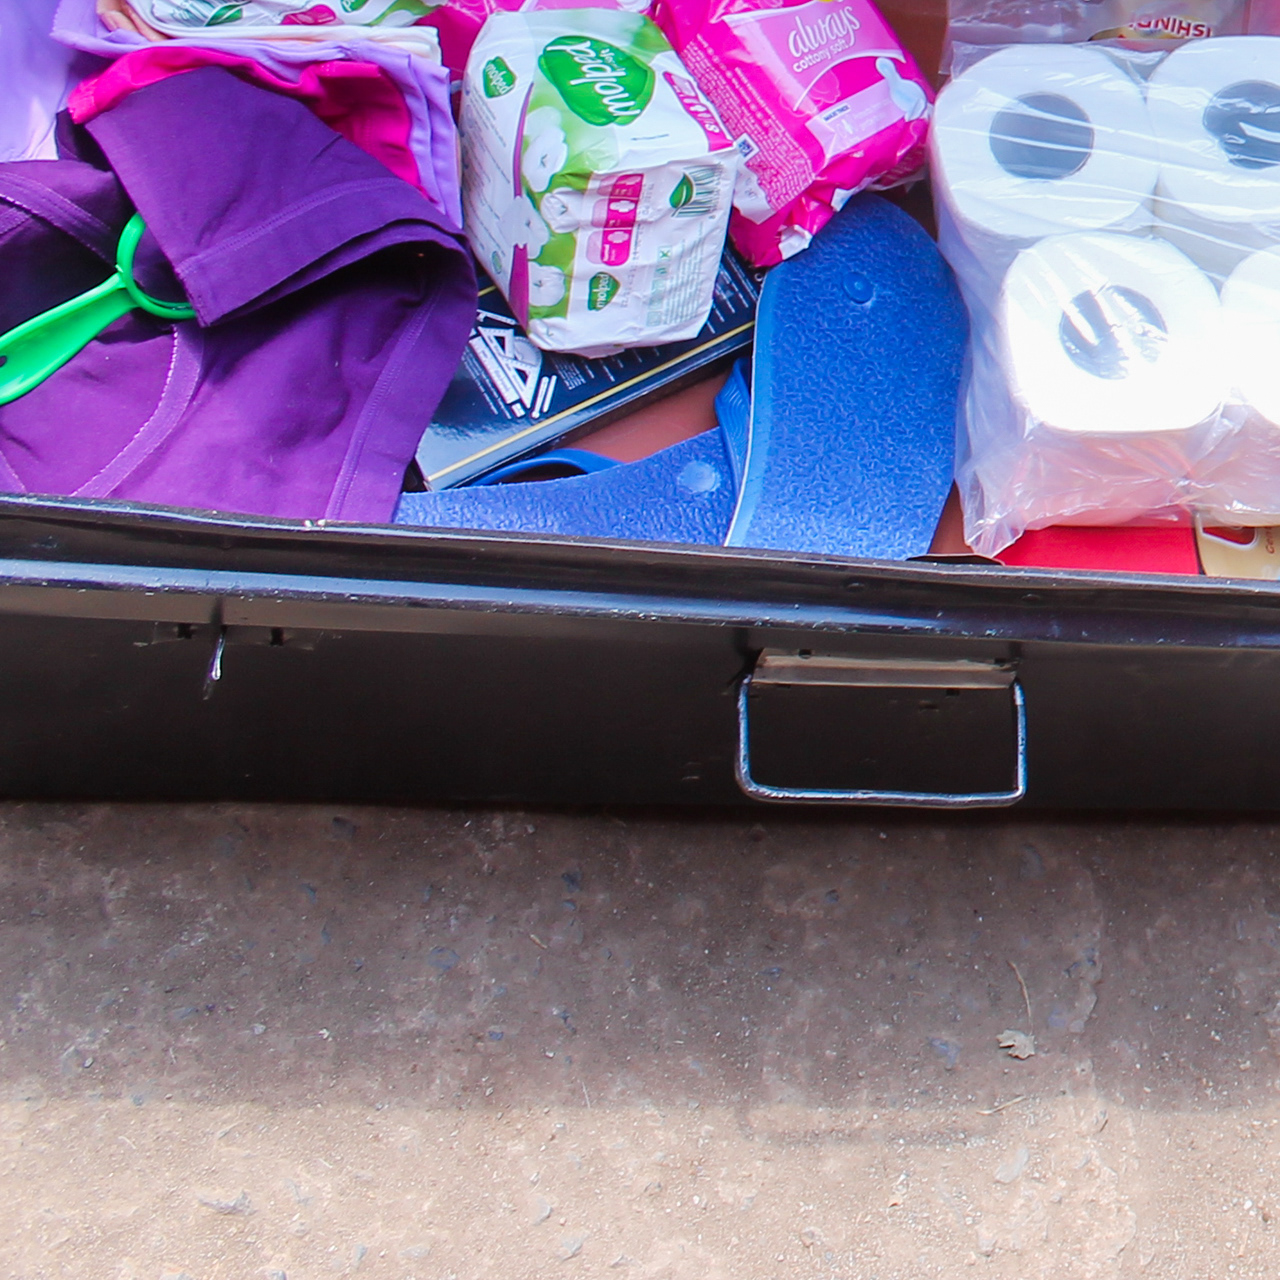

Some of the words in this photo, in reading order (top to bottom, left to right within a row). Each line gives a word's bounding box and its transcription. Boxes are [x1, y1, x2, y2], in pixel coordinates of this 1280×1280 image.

[788, 6, 863, 59] always
[792, 49, 831, 73] cottony
[830, 37, 852, 61] soft
[545, 39, 641, 117] molped
